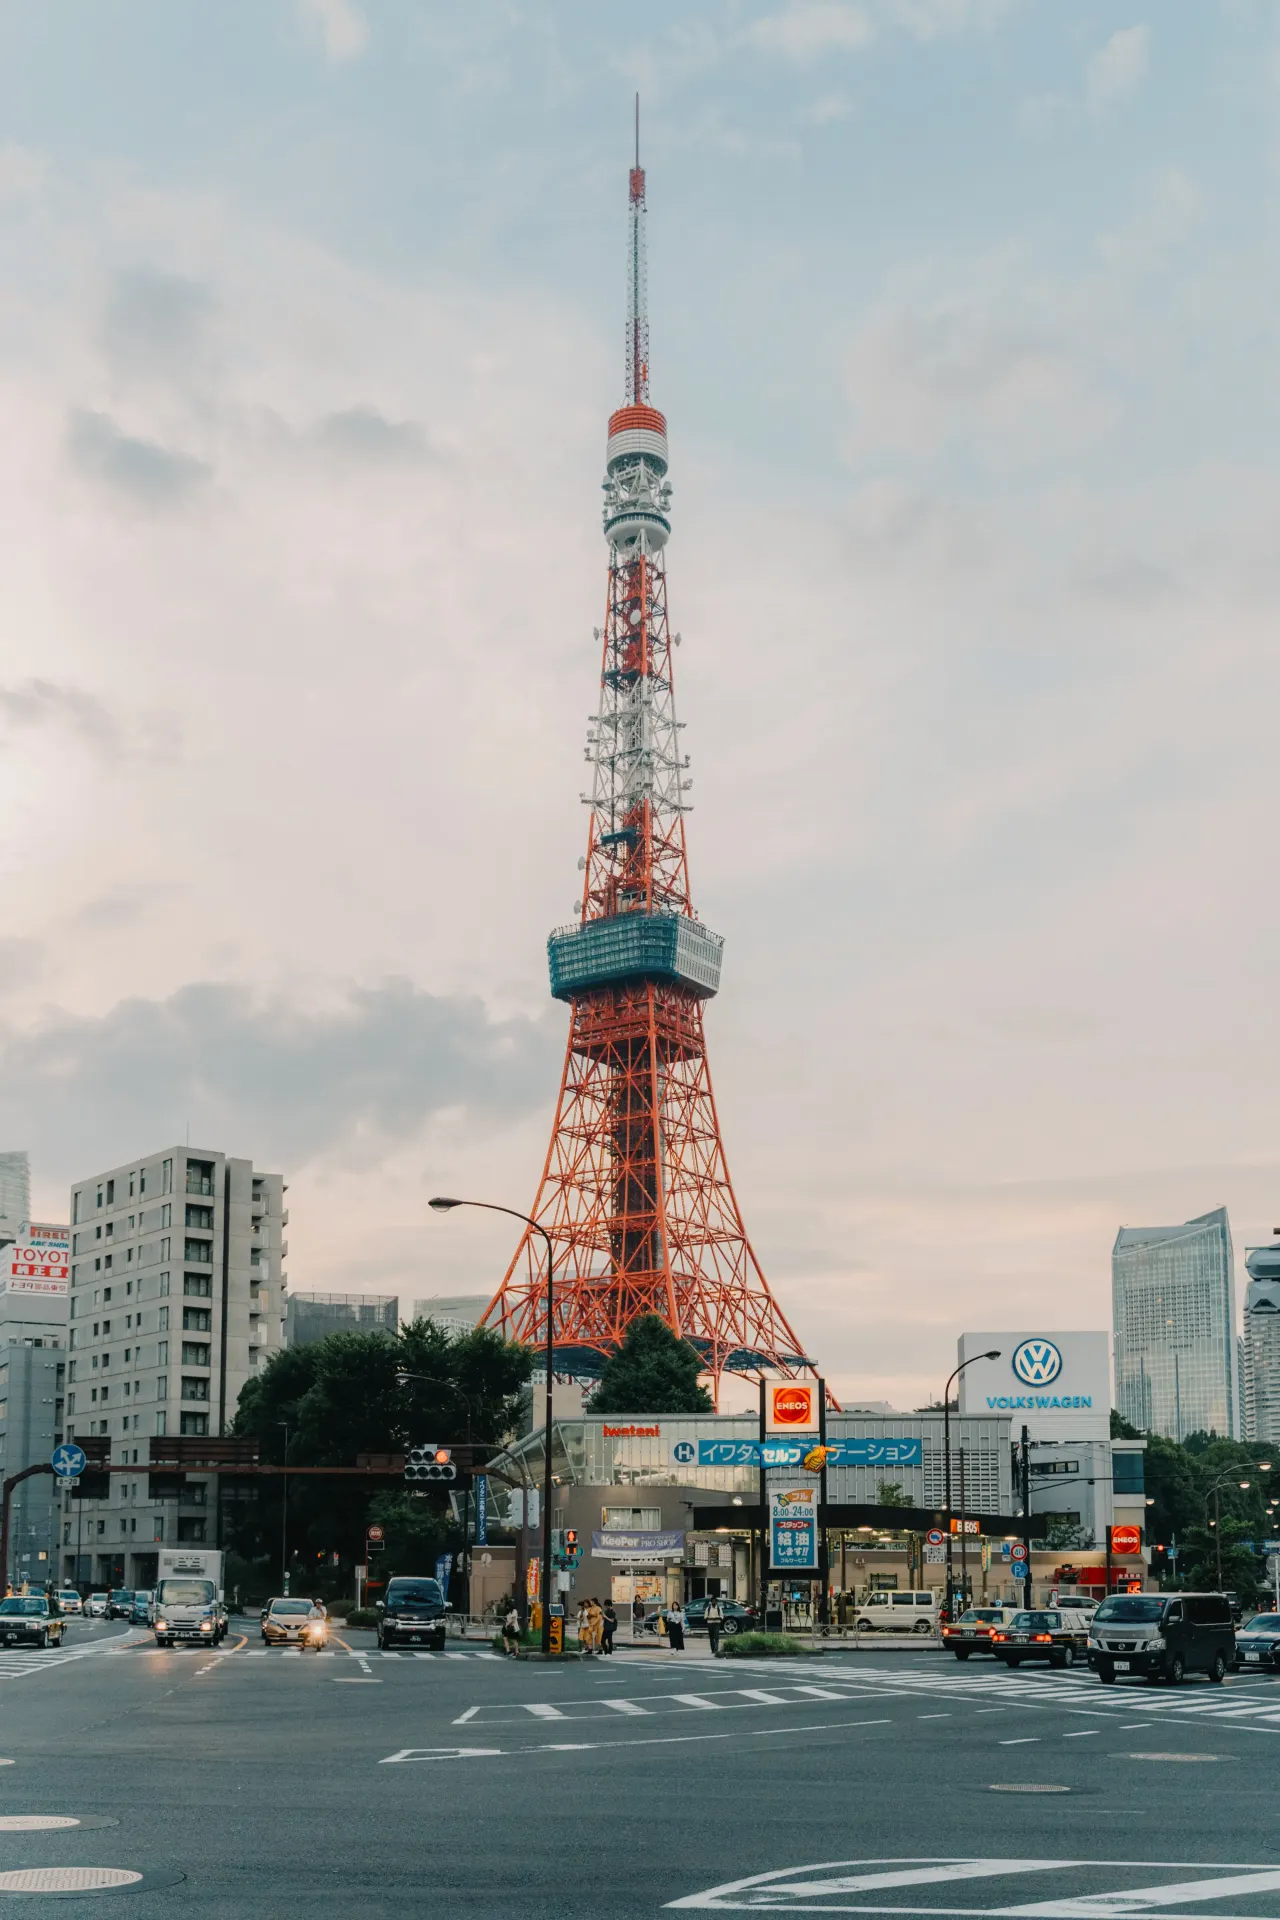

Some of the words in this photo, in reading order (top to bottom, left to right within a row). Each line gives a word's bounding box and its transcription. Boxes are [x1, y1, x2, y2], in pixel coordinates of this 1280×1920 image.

[776, 1402, 808, 1410] ENEOS
[986, 1396, 1092, 1408] VOLKSWAGEN
[603, 1423, 660, 1437] Iwatani
[762, 1448, 801, 1463] セルフ
[792, 1492, 808, 1500] フル
[957, 1520, 978, 1533] EEOS
[602, 1535, 639, 1547] KeePer
